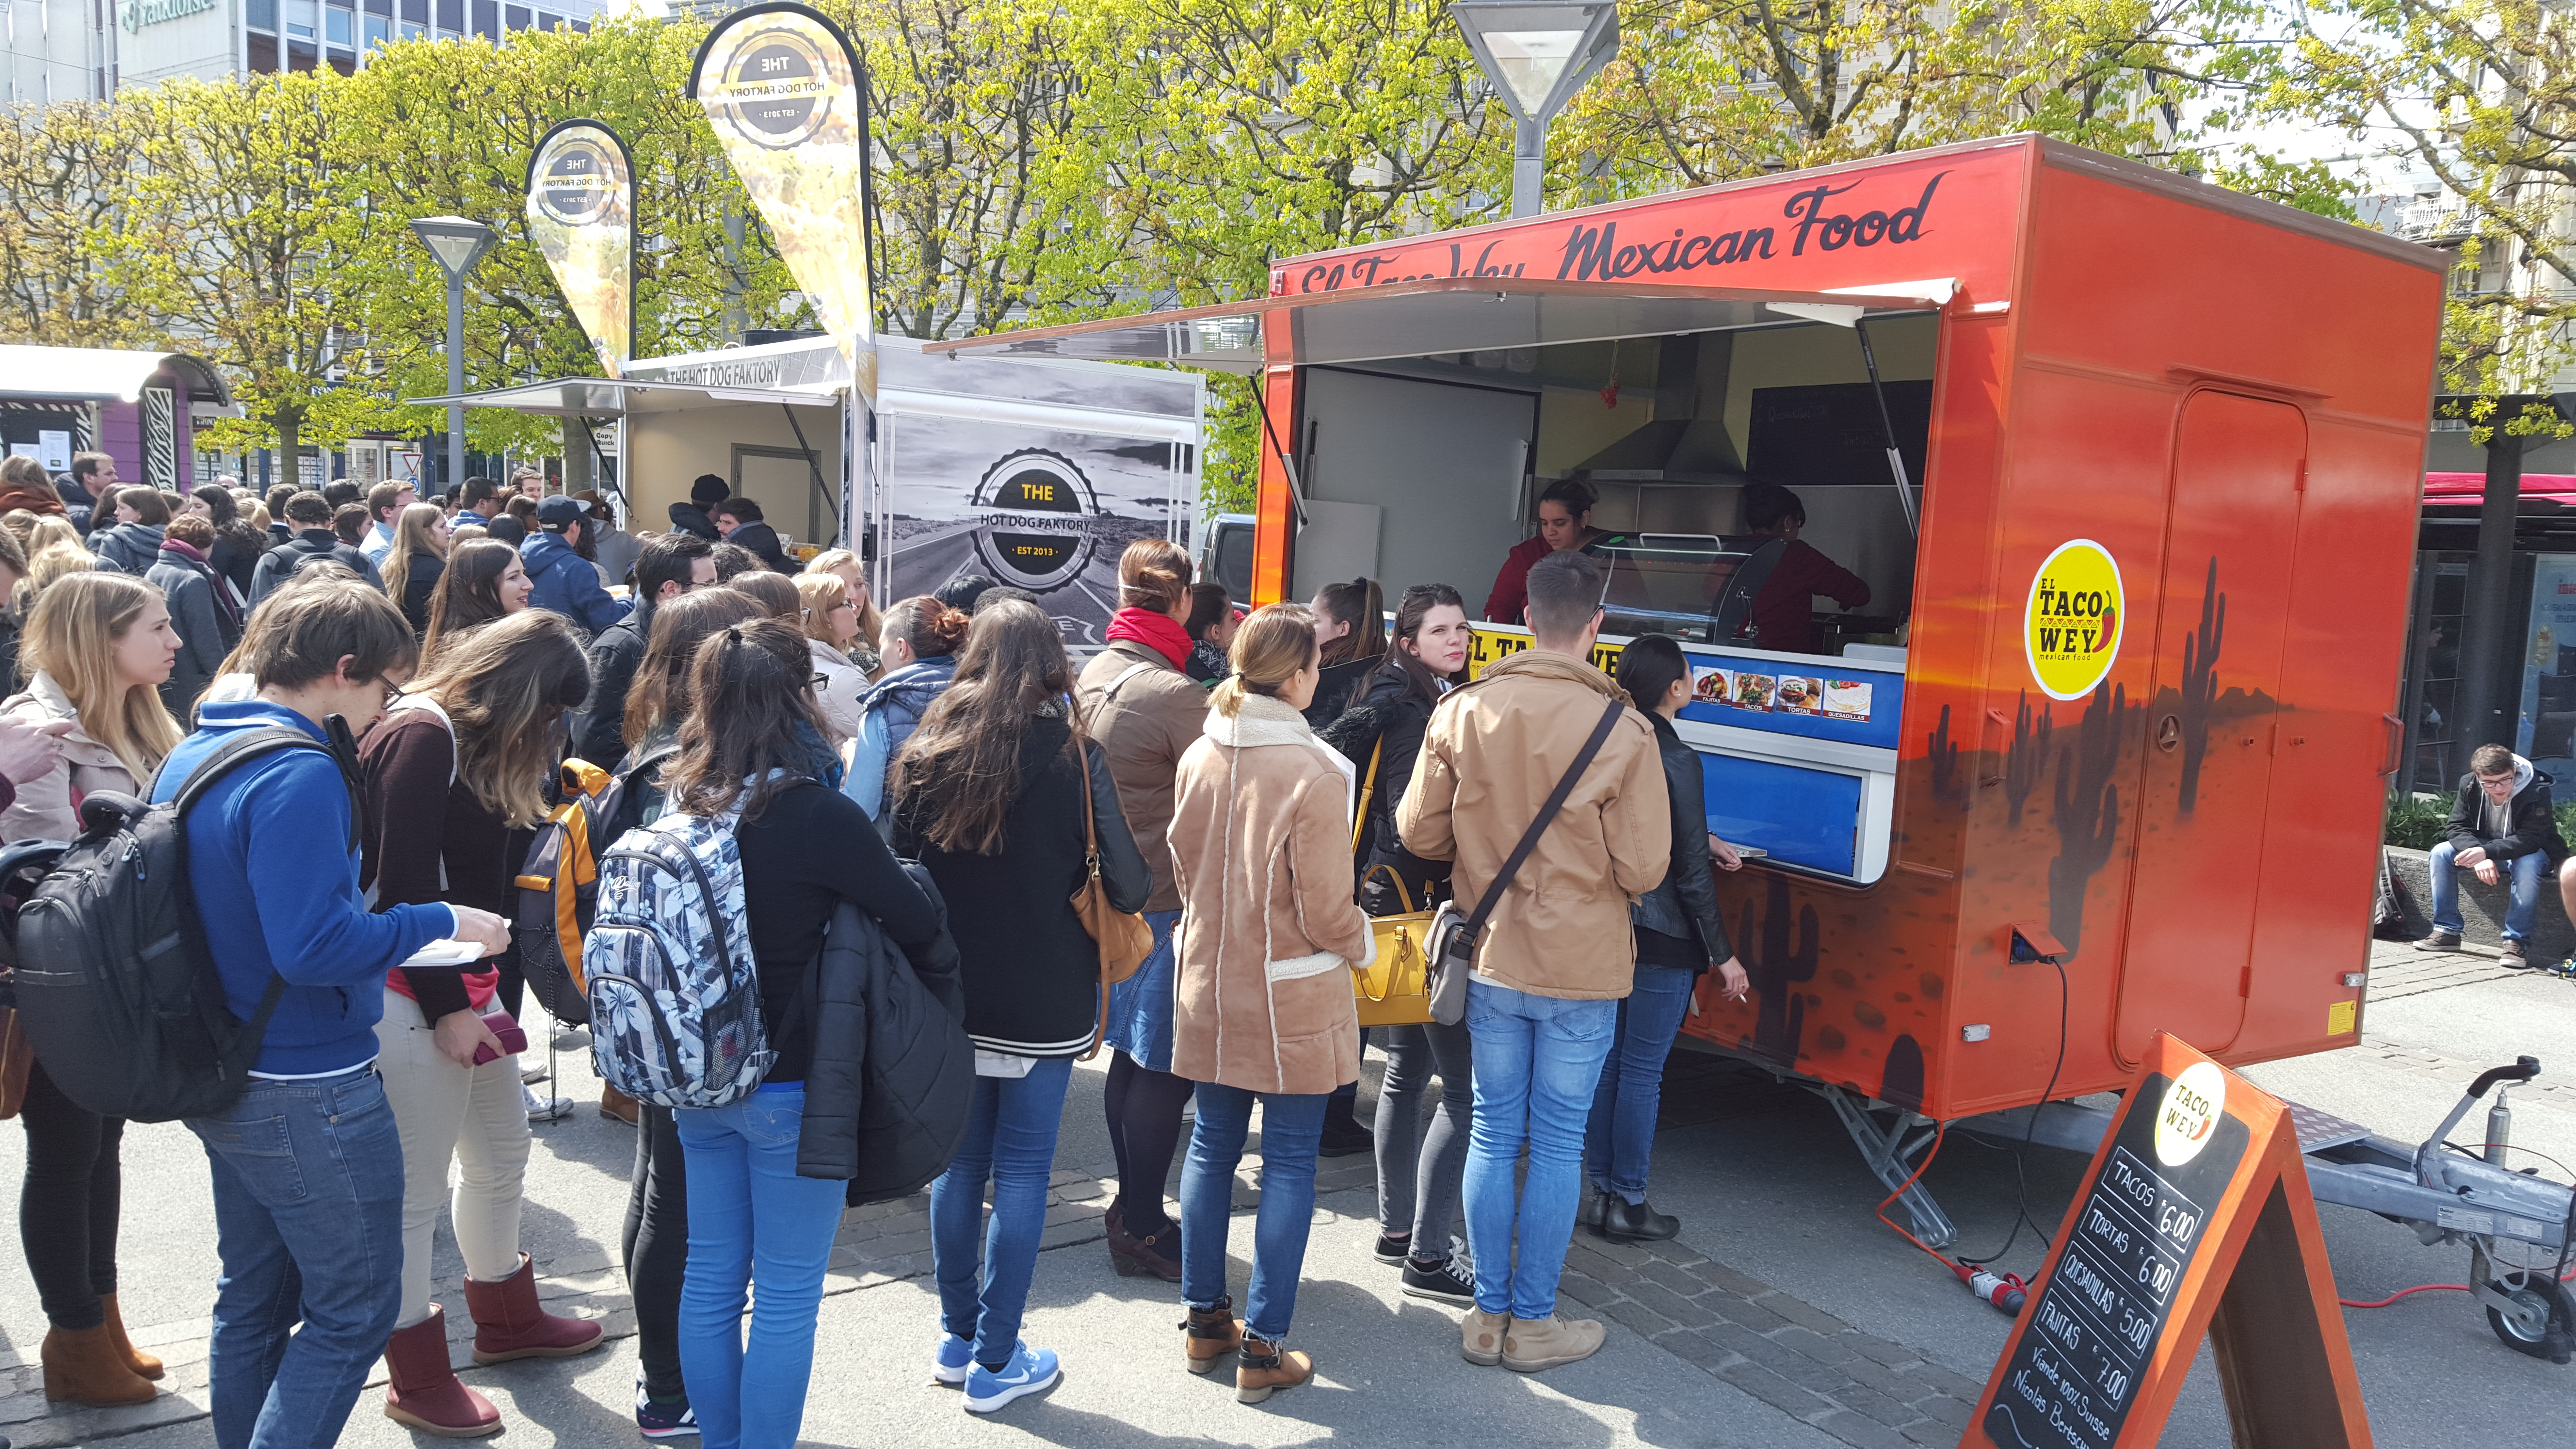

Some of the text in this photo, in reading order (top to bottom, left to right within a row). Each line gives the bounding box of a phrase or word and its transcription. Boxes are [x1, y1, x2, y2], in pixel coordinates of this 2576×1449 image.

[1556, 222, 1780, 281] Mexican
[1784, 170, 1953, 257] Food
[689, 368, 708, 385] HOT
[710, 365, 731, 386] DOG
[734, 359, 781, 385] FAKTORY
[1021, 483, 1054, 501] THE
[981, 514, 1091, 531] HOT DOG FAKTORY
[1017, 546, 1053, 556] EST 2013
[2041, 578, 2055, 589] EL
[2040, 590, 2103, 618] TACO
[2040, 628, 2097, 653] WEY
[1744, 703, 1763, 711] TACOS
[1787, 707, 1811, 715] TORTAS
[1828, 711, 1865, 721] QUESADILLAS
[2175, 1084, 2209, 1116] TACO
[2166, 1108, 2197, 1138] WEY
[2116, 1160, 2155, 1207] TACOS
[2160, 1206, 2195, 1242] 6.00
[2089, 1208, 2129, 1253] TORTAS
[2139, 1255, 2172, 1292] 6.00
[2064, 1254, 2115, 1314] QUESADILLAS
[2119, 1307, 2150, 1350] 5.00
[2040, 1300, 2081, 1350] FAJITAS
[2096, 1356, 2127, 1400] 7.00
[2012, 1369, 2047, 1413] Nicolas
[2032, 1346, 2060, 1385] Viande
[2077, 1395, 2110, 1441] Suisse
